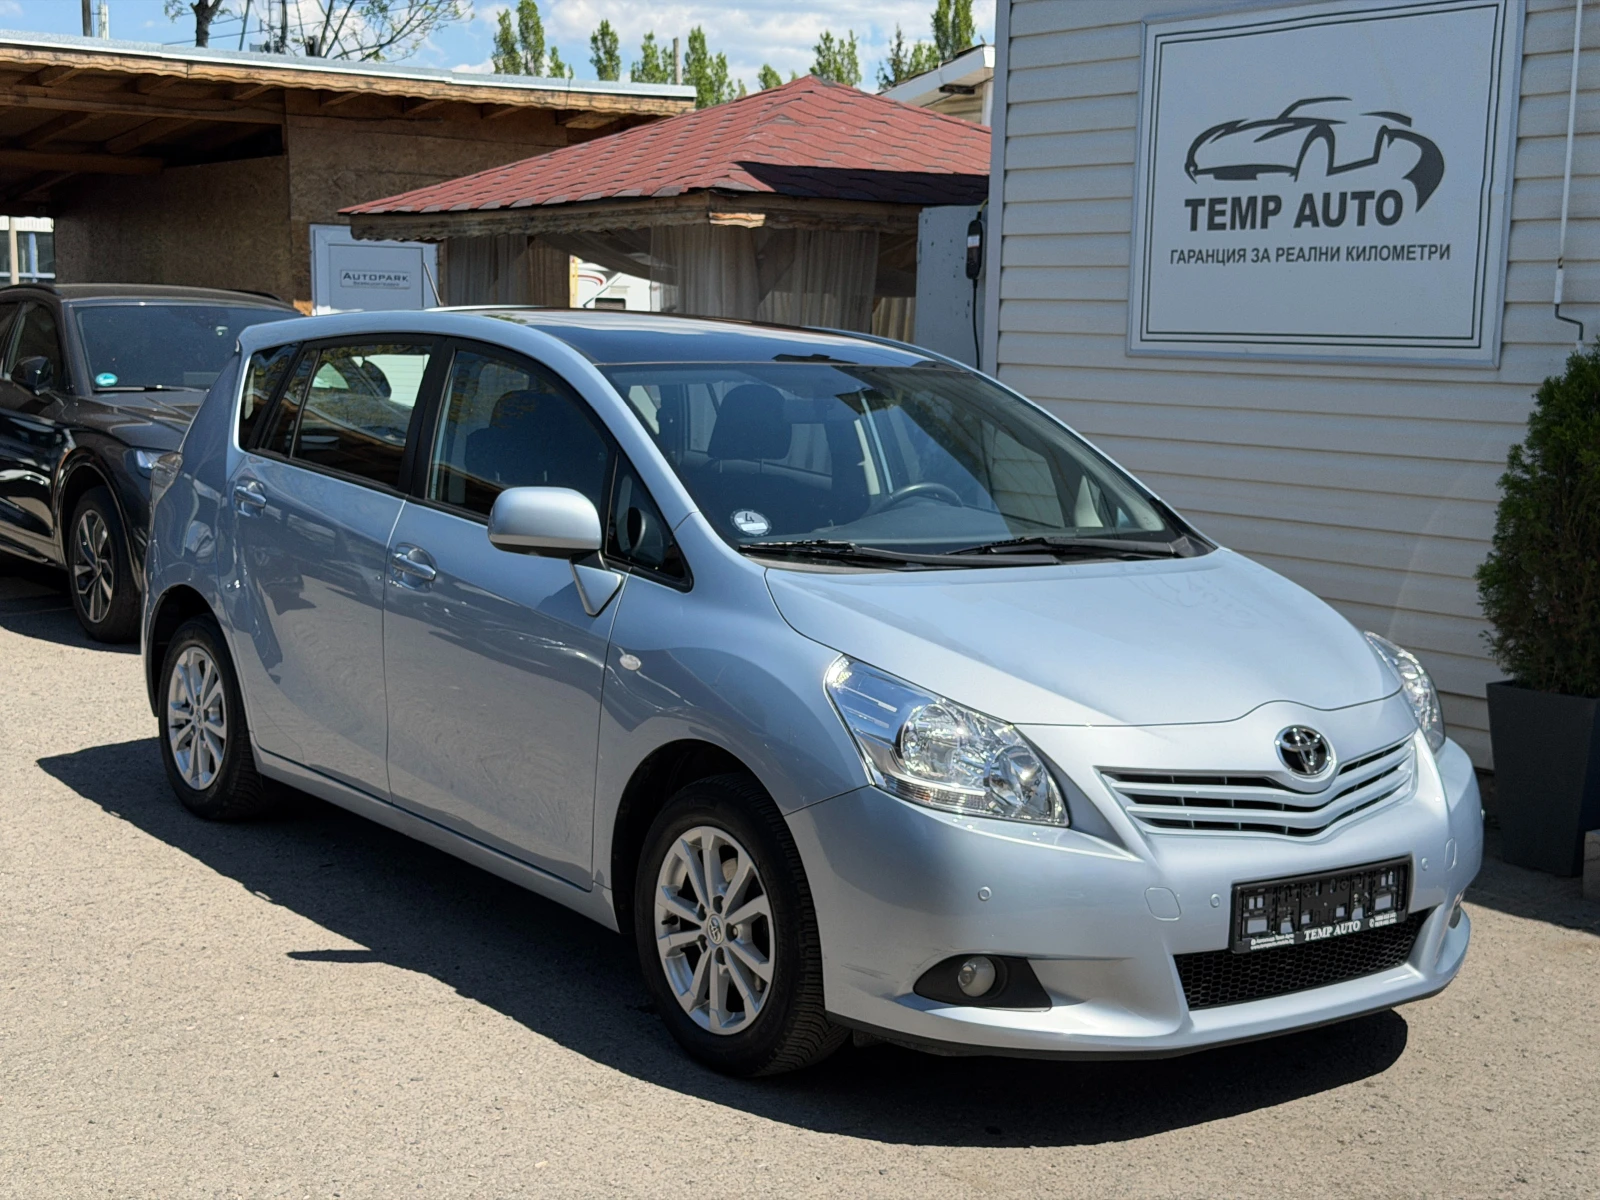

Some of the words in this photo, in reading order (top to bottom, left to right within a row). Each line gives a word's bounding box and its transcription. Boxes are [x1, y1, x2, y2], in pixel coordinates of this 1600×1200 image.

[1184, 195, 1283, 232] TEMP
[1293, 189, 1404, 229] AUTO
[1170, 247, 1247, 266] ГАРАНЦИЯ
[1250, 247, 1272, 264] ЗА
[1275, 245, 1342, 263] РЕАЛНИ
[1345, 243, 1451, 262] КИЛОМЕТРИ
[343, 272, 409, 282] AUTOPARK
[1303, 926, 1333, 942] TEMP
[1333, 920, 1361, 936] AUTO
